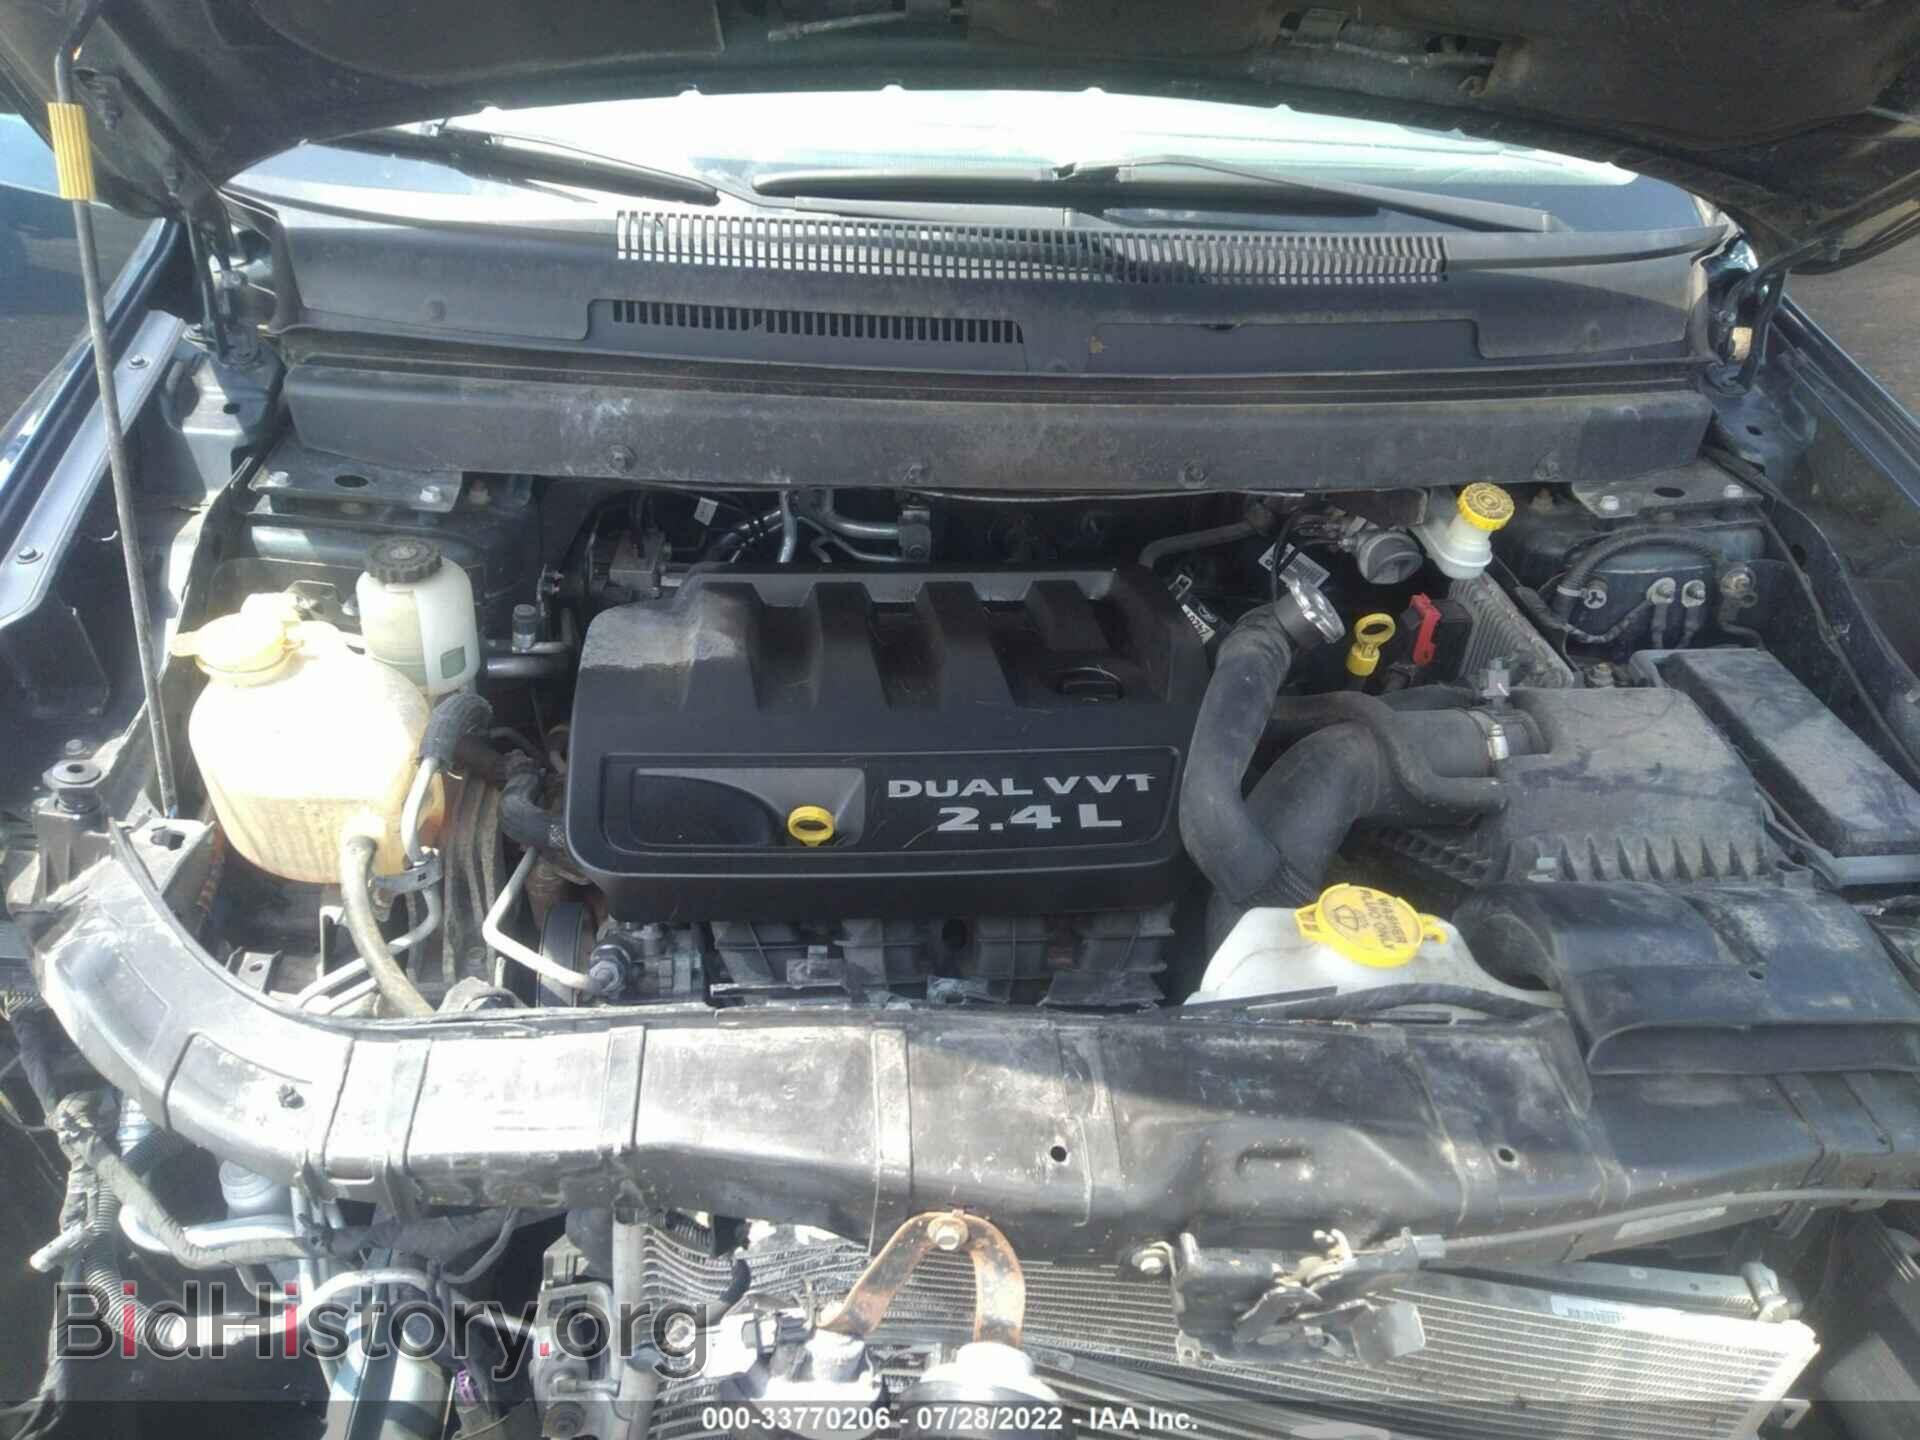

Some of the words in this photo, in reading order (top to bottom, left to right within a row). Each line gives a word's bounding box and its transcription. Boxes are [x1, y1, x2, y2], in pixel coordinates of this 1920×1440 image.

[888, 778, 1034, 798] DUAL
[1043, 773, 1155, 795] VVT
[937, 804, 1061, 832] 2.4
[1078, 803, 1122, 828] L
[1377, 897, 1408, 944] WASHER
[1373, 921, 1396, 950] ONLY
